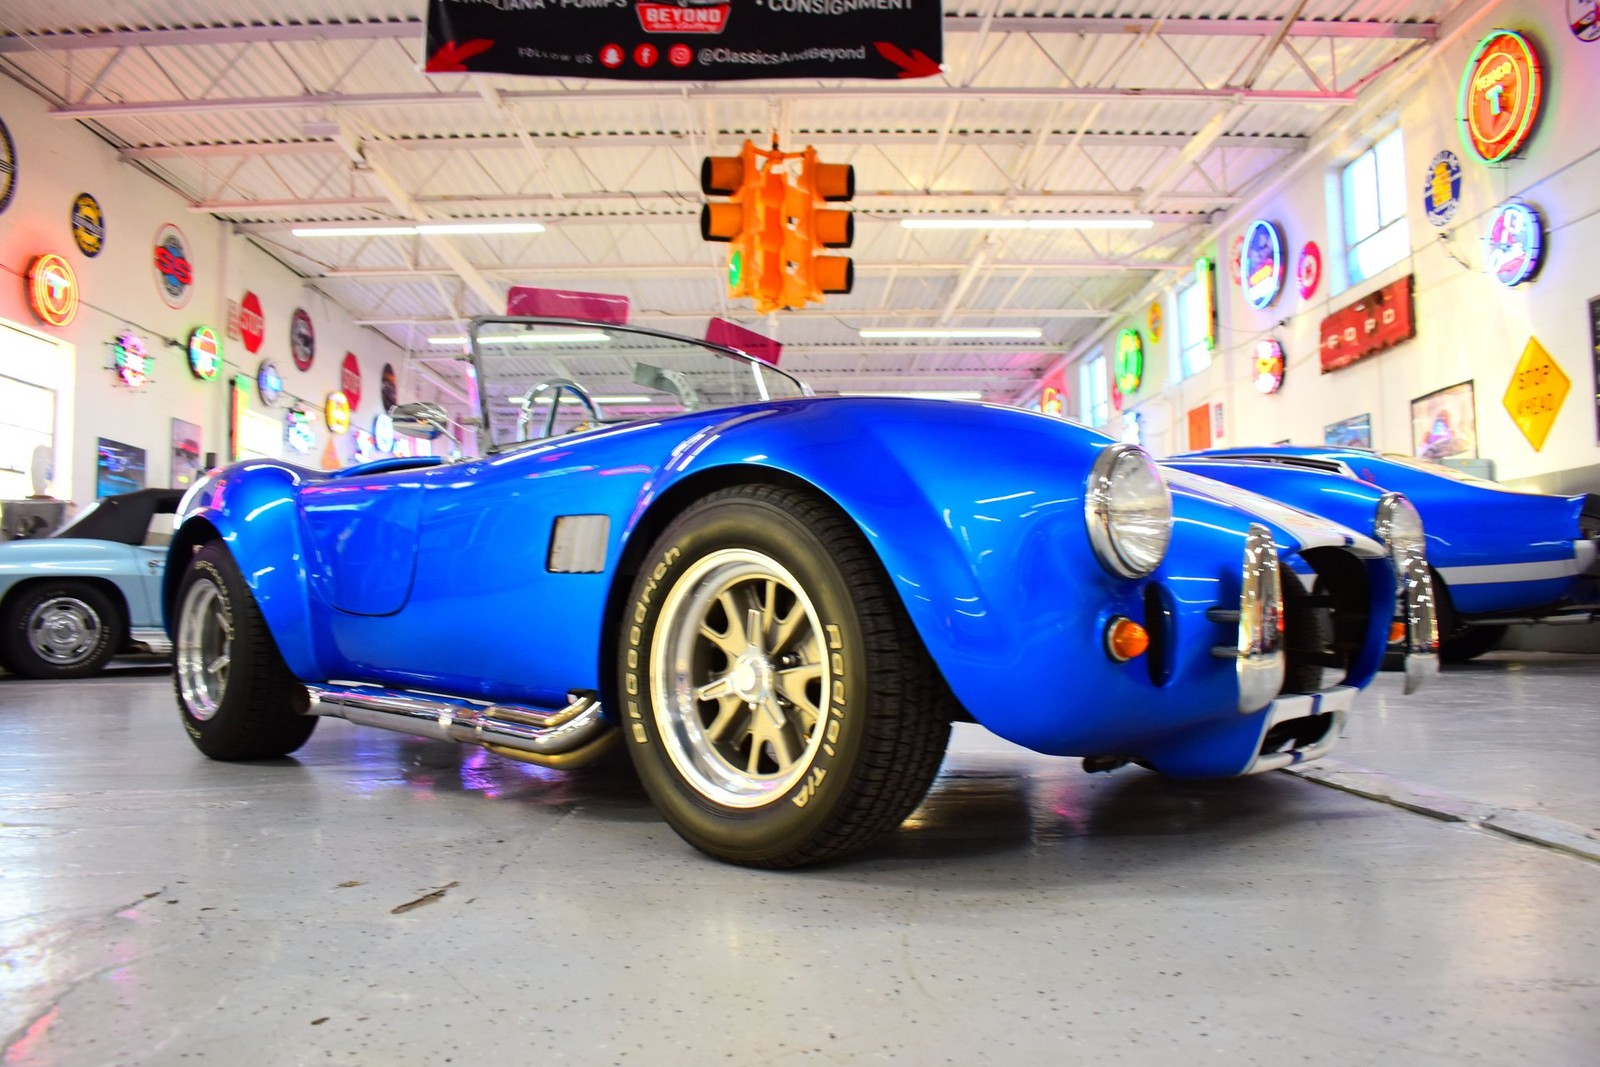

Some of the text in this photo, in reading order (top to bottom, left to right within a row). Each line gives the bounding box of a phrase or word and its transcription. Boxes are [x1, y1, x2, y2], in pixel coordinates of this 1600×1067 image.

[646, 7, 721, 23] BEYOND
[517, 47, 593, 64] FOLLOW US
[697, 46, 867, 66] @ClassicsAndBeyond
[154, 246, 193, 286] SS
[791, 765, 828, 808] T/A
